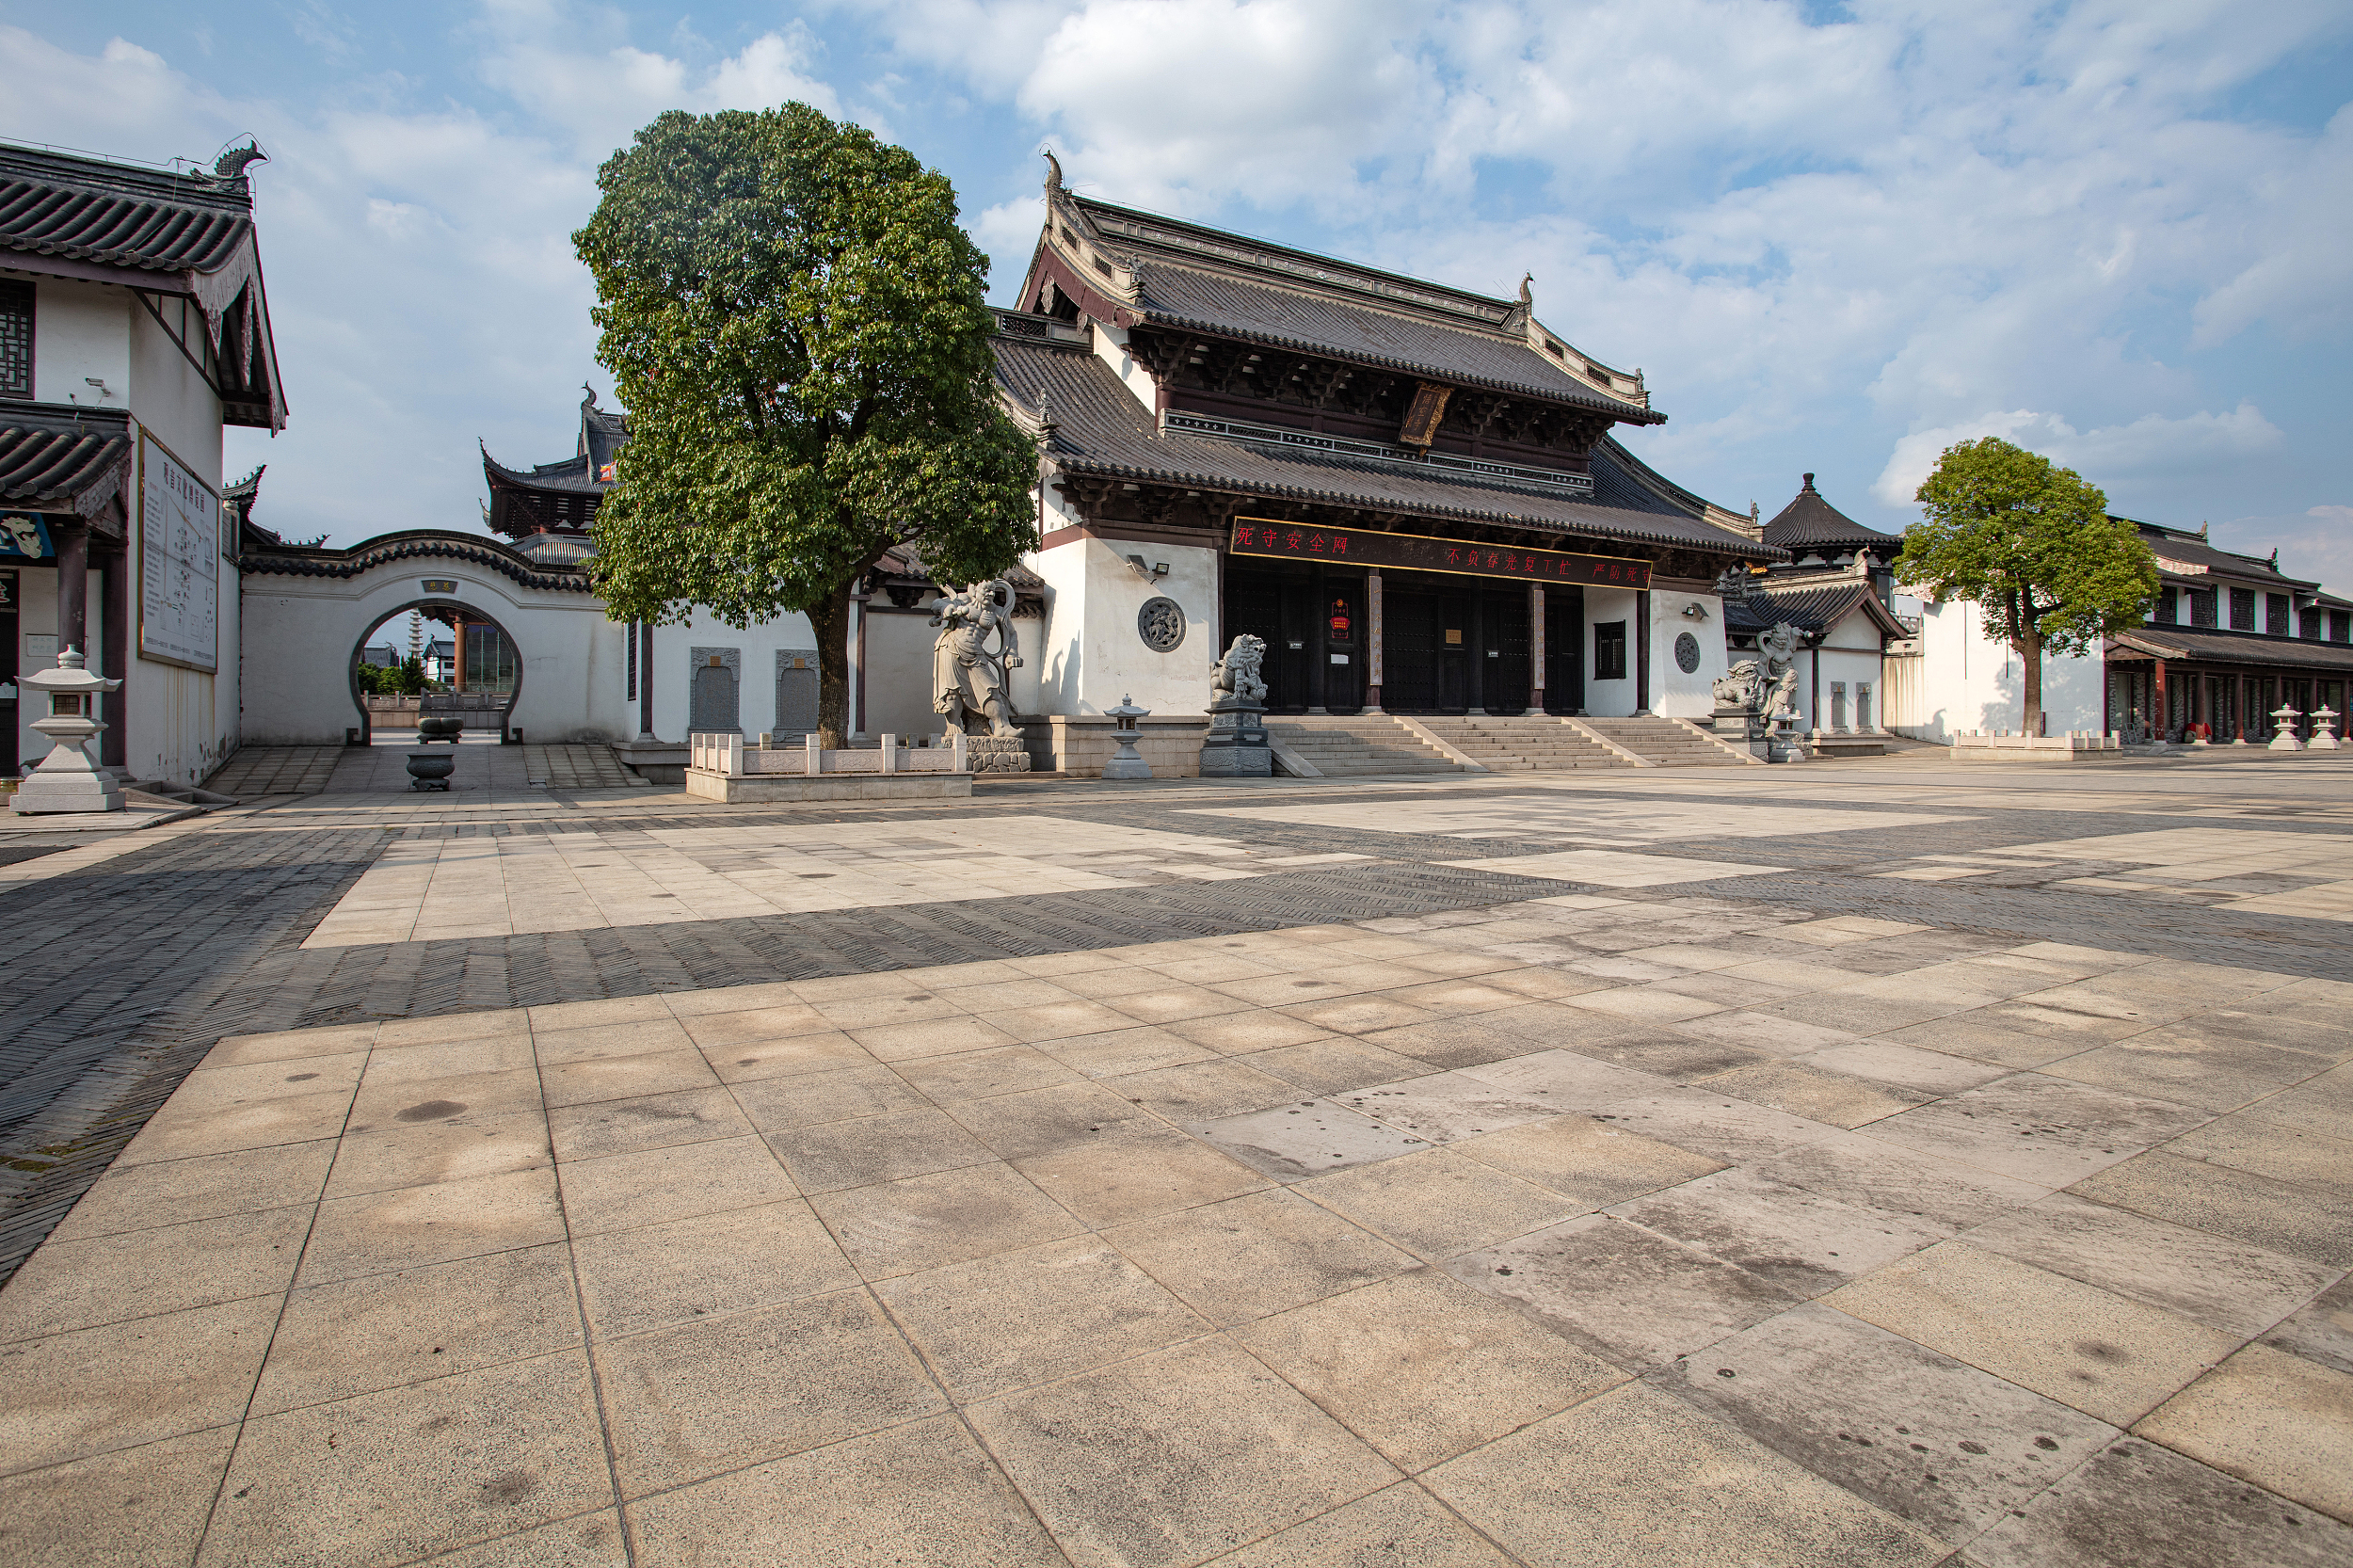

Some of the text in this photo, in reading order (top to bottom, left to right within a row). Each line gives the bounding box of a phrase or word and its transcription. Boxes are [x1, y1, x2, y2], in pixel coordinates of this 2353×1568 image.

[164, 462, 204, 513] 观音文化博览园
[1235, 527, 1348, 554] 死守安全网
[1446, 548, 1572, 575] 不负春光复工忙
